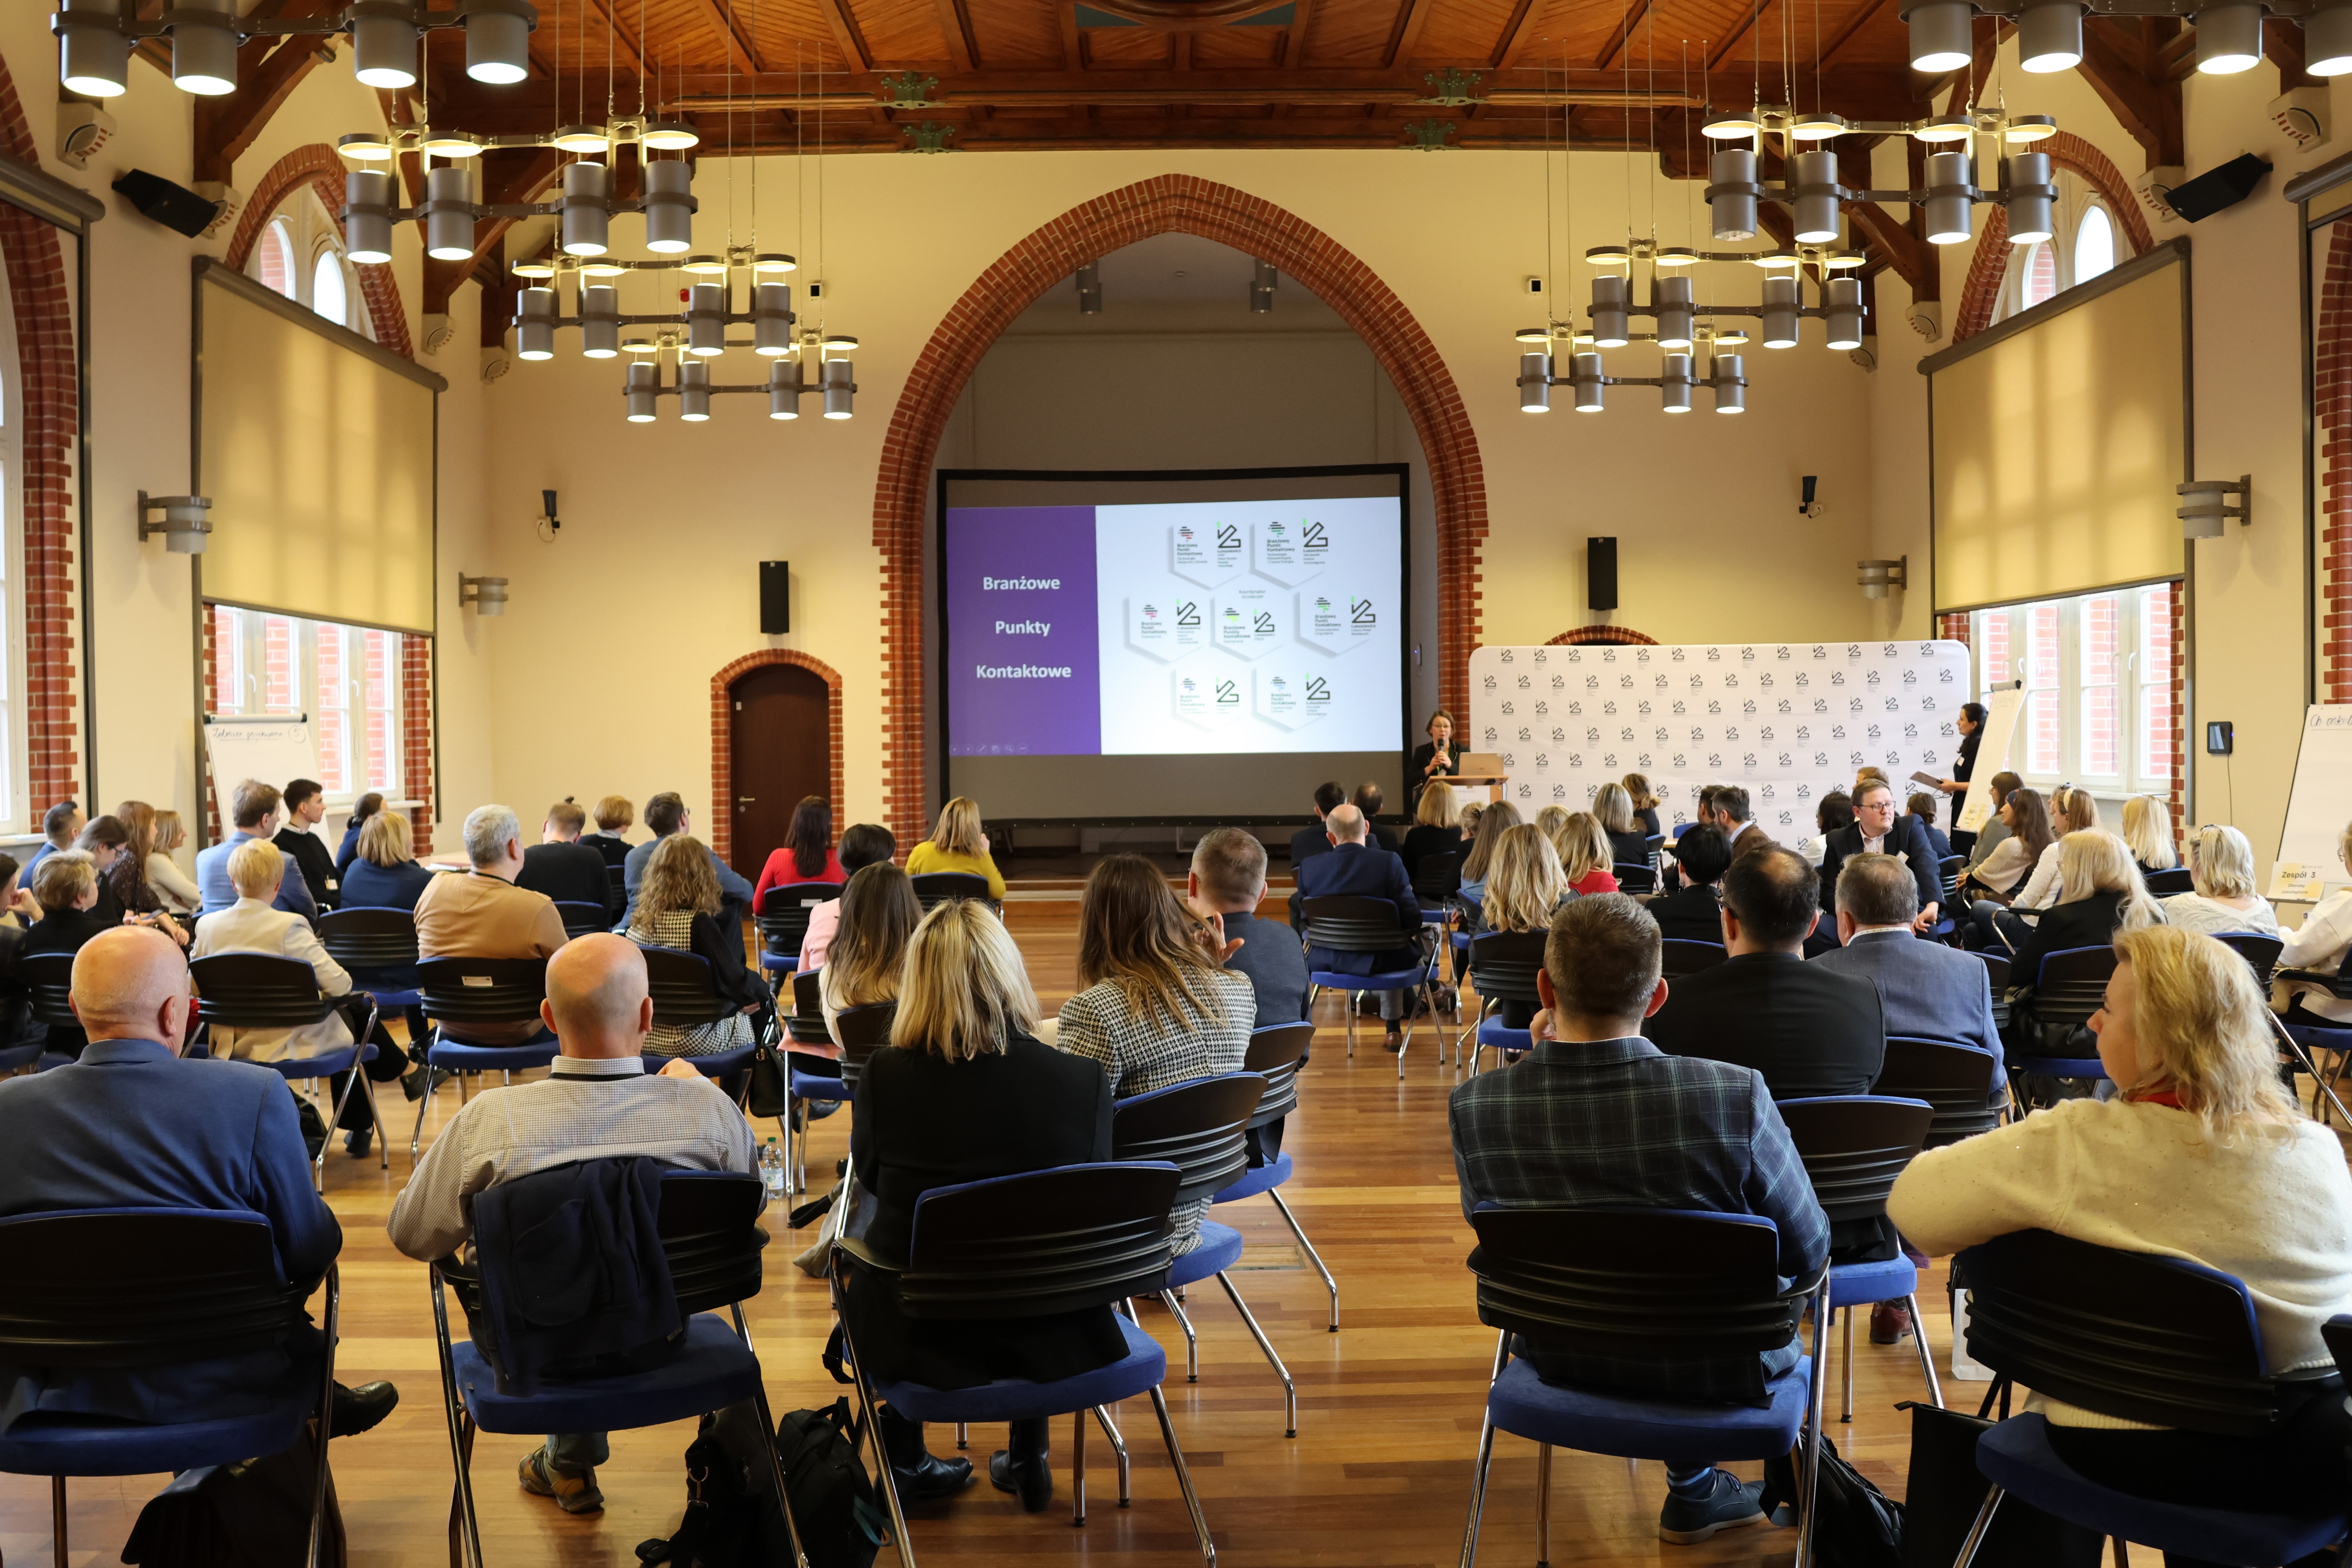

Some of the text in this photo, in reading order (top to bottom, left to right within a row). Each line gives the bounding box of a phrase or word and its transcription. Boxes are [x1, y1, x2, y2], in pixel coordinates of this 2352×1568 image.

[983, 575, 1061, 591] Branżowe
[995, 620, 1051, 637] Punkty
[976, 663, 1072, 679] Kontaktowe
[2282, 871, 2307, 879] Zespół
